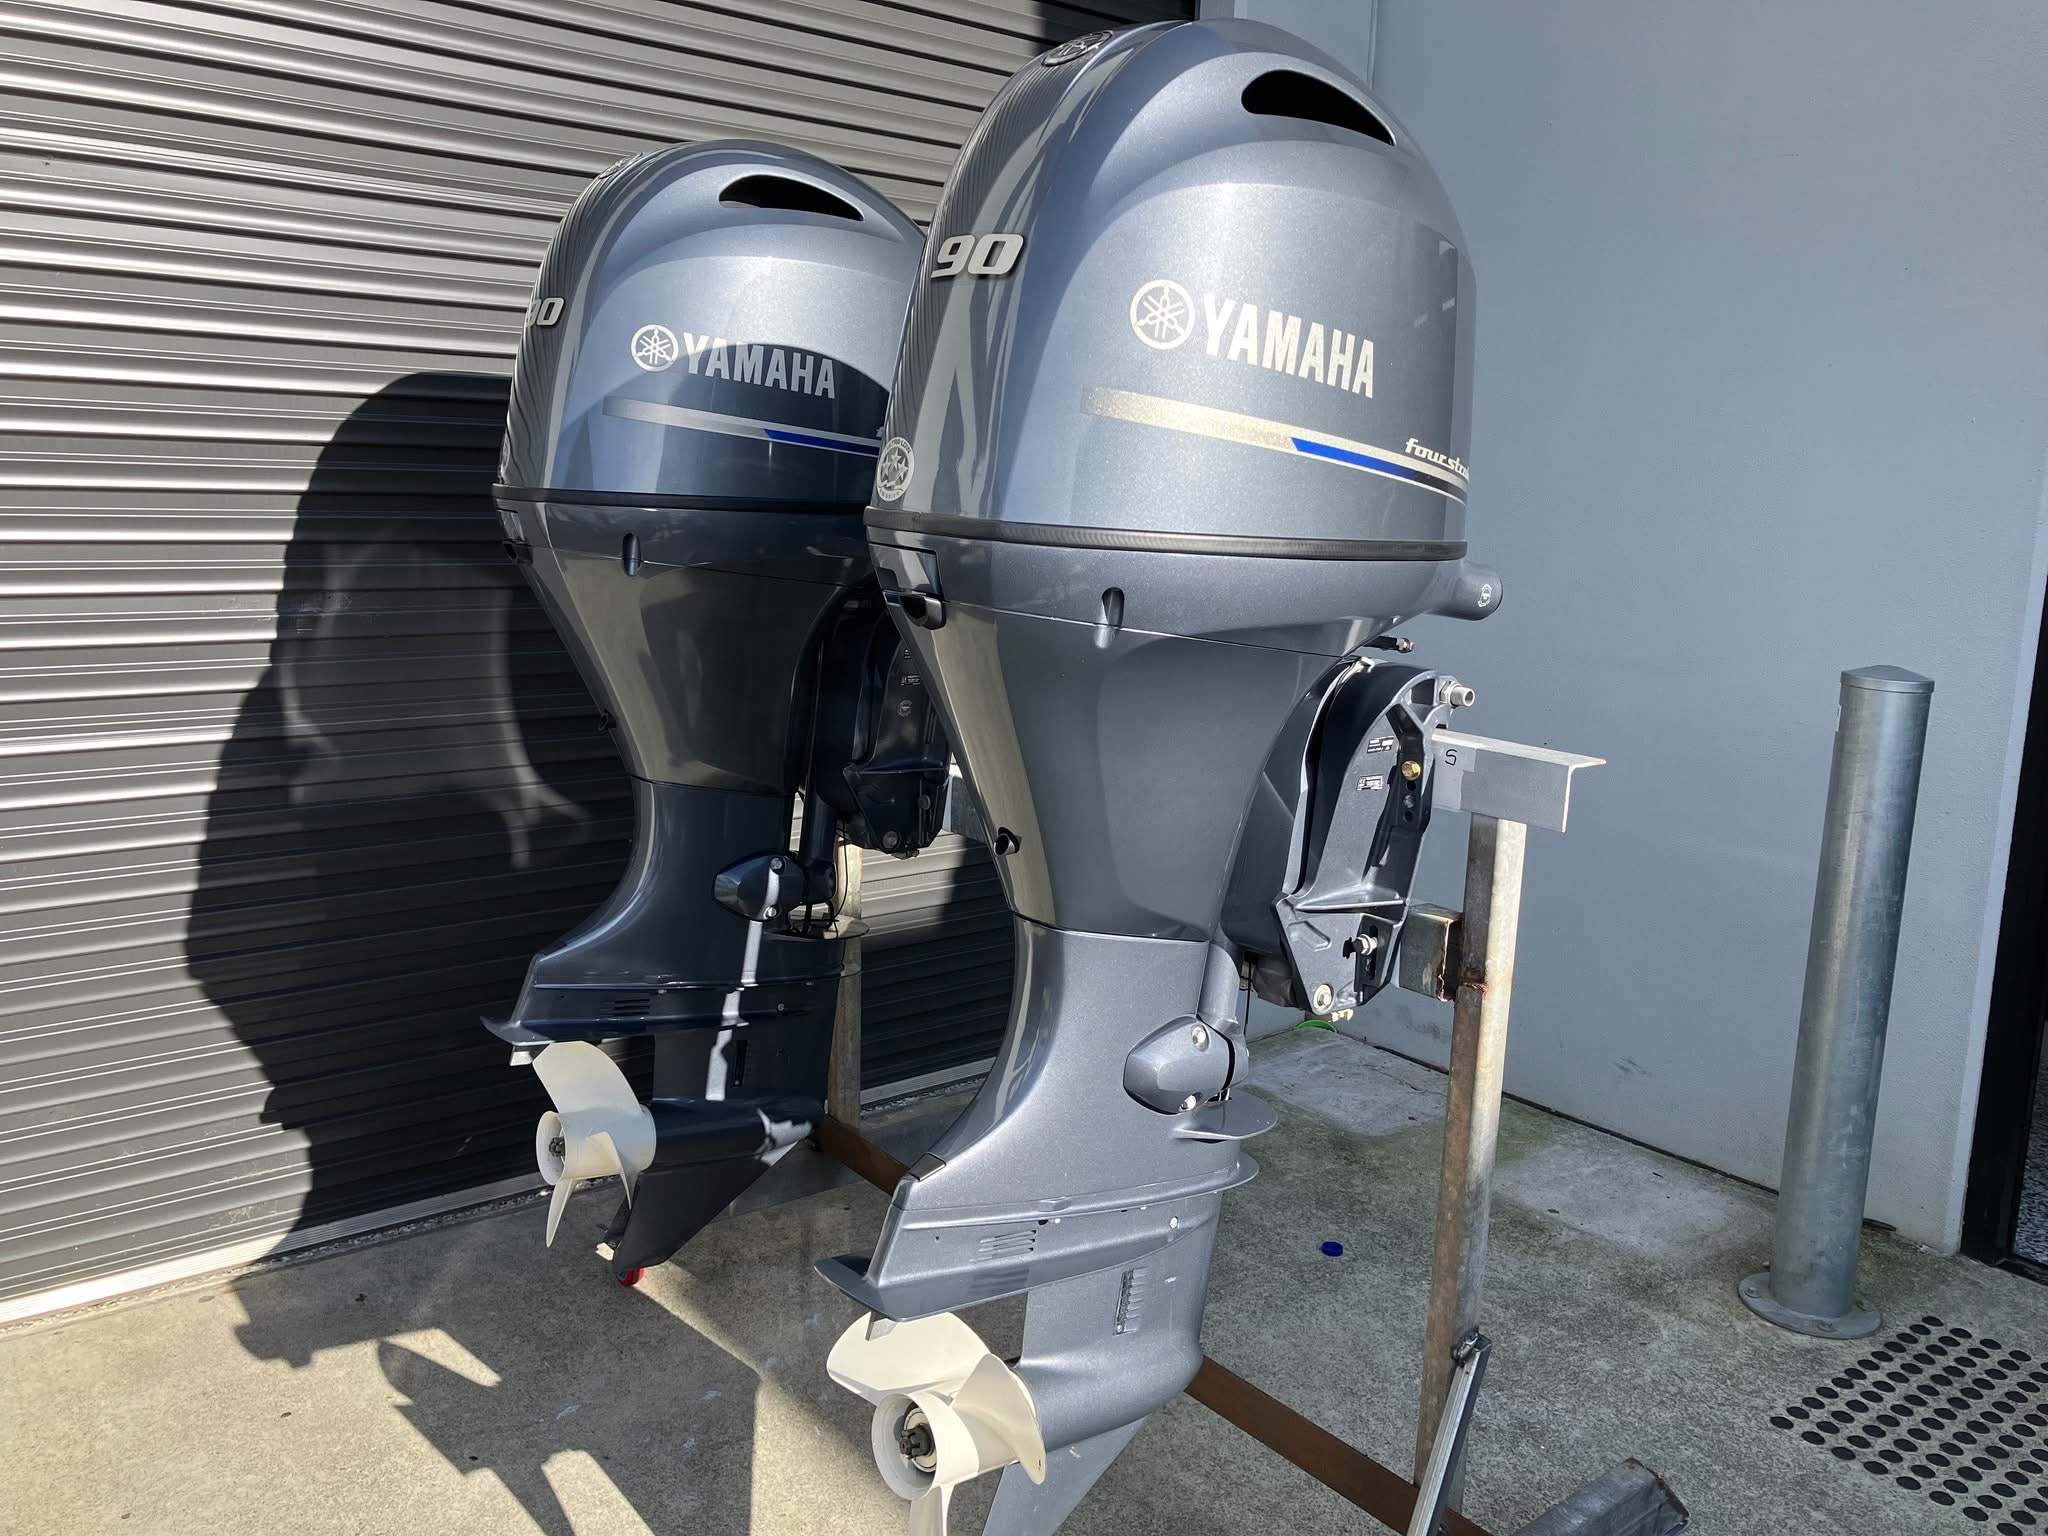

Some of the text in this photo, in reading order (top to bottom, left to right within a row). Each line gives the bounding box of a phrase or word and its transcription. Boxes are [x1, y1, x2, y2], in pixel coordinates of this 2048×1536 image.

[931, 233, 1024, 278] 90
[683, 332, 836, 399] YAMAHA
[1203, 293, 1374, 399] YAMAHA
